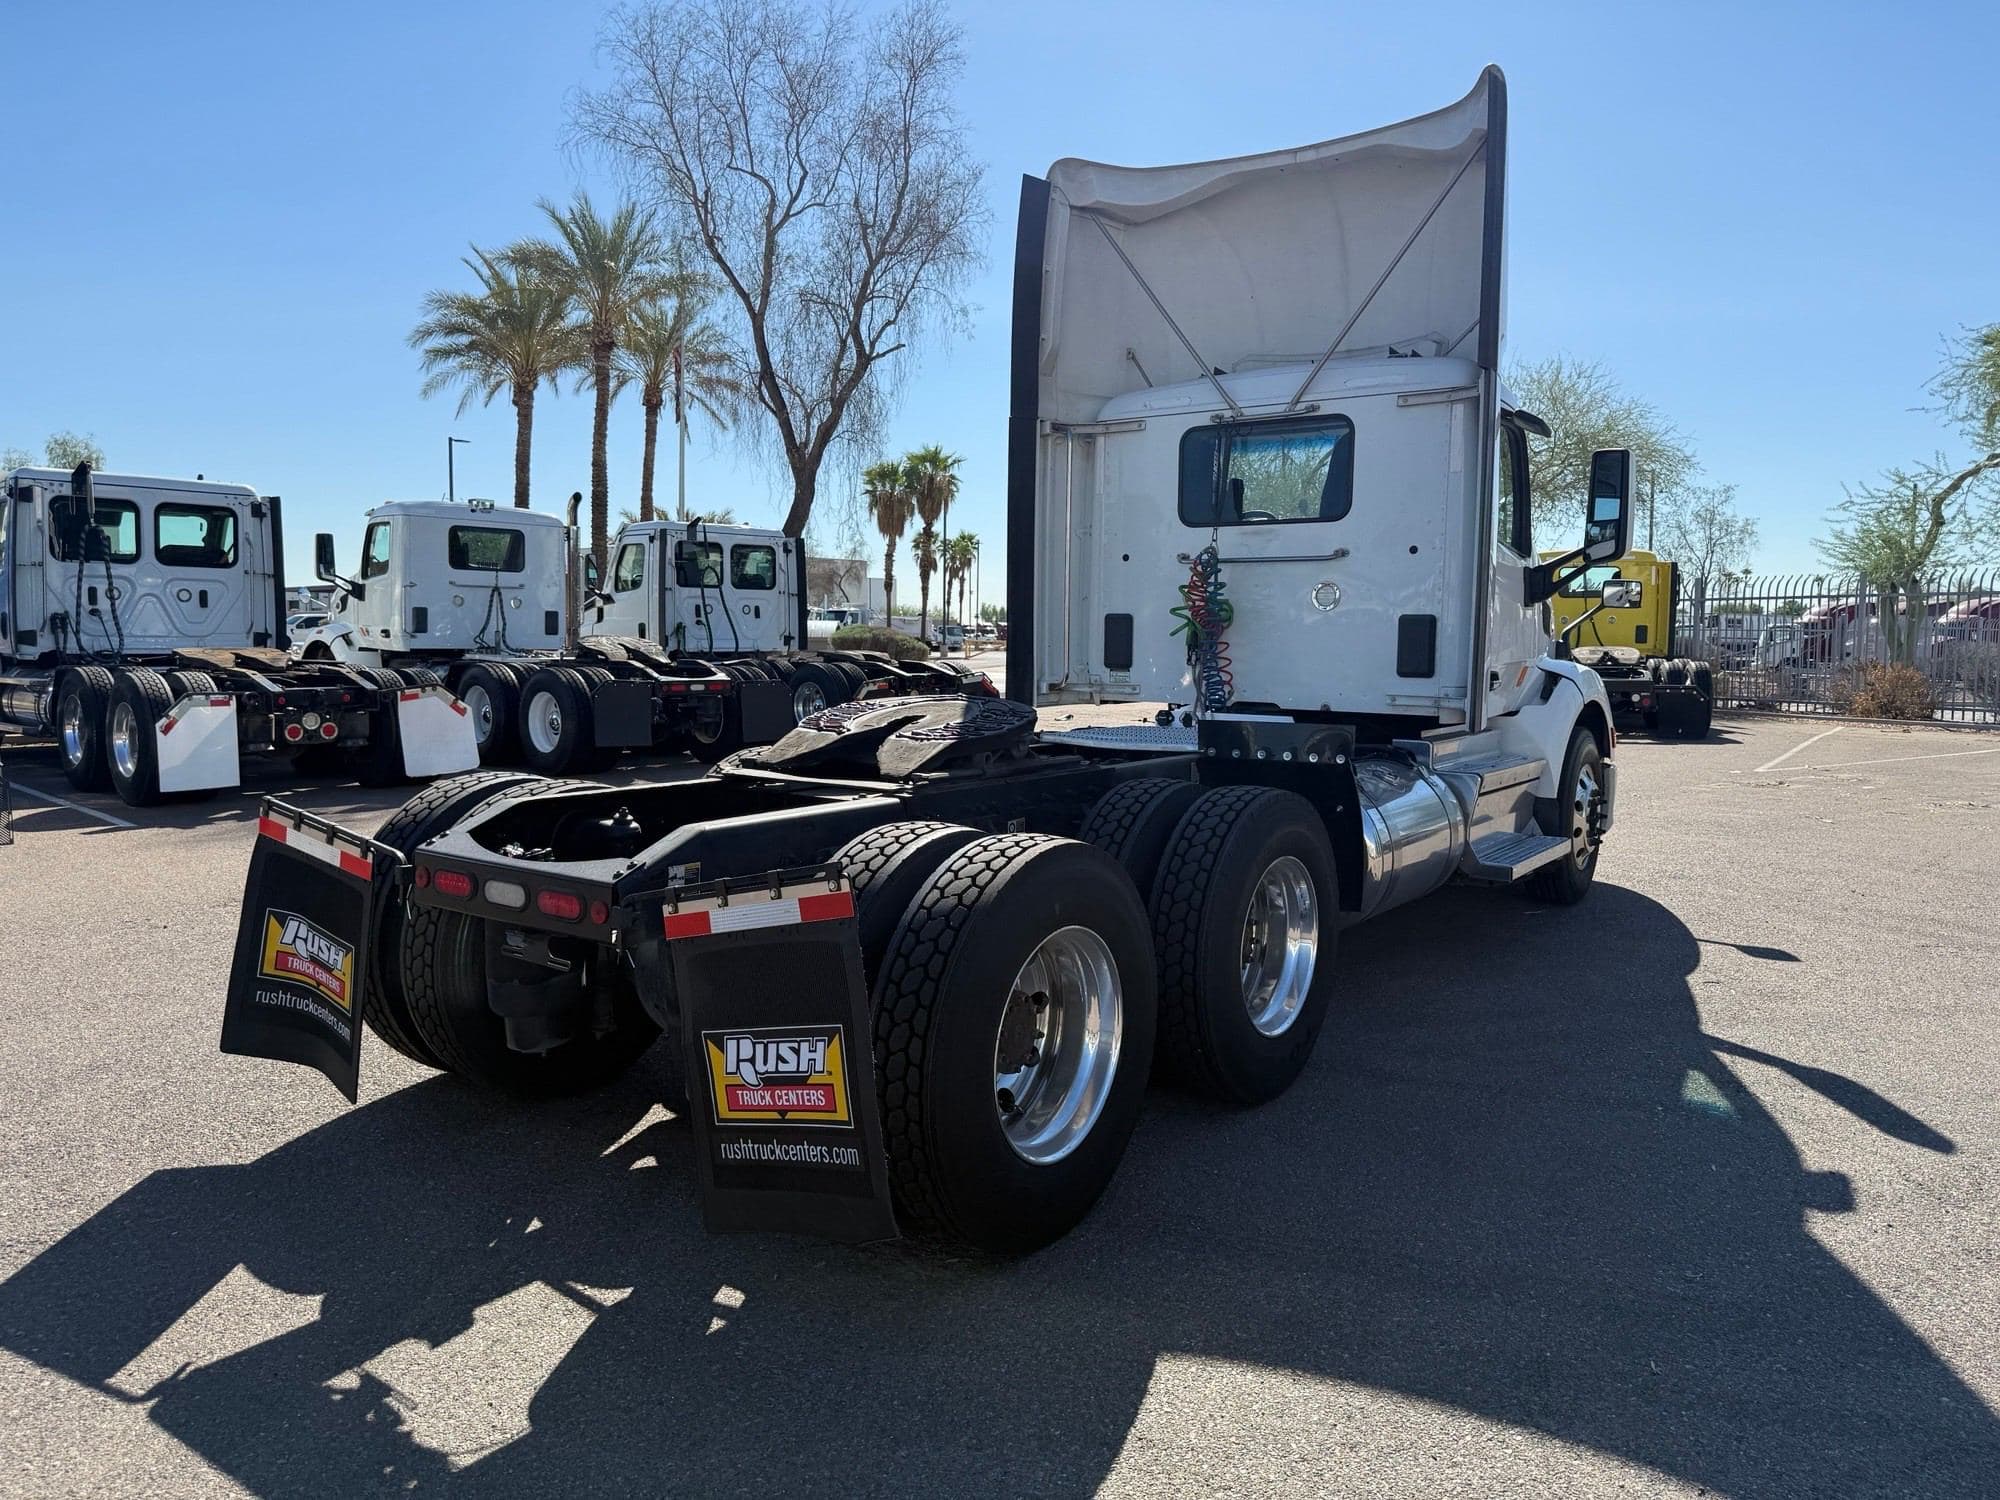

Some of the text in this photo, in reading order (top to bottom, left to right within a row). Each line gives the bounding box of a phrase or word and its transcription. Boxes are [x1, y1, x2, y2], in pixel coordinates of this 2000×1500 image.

[280, 918, 345, 972] RUSH
[287, 956, 341, 993] TRUCK CENTERS
[255, 990, 351, 1042] rushtruckcenters.com
[726, 1038, 826, 1087] RUSH
[736, 1090, 826, 1106] TRUCK CENTERS
[720, 1138, 860, 1166] rushtruckcenters.com
